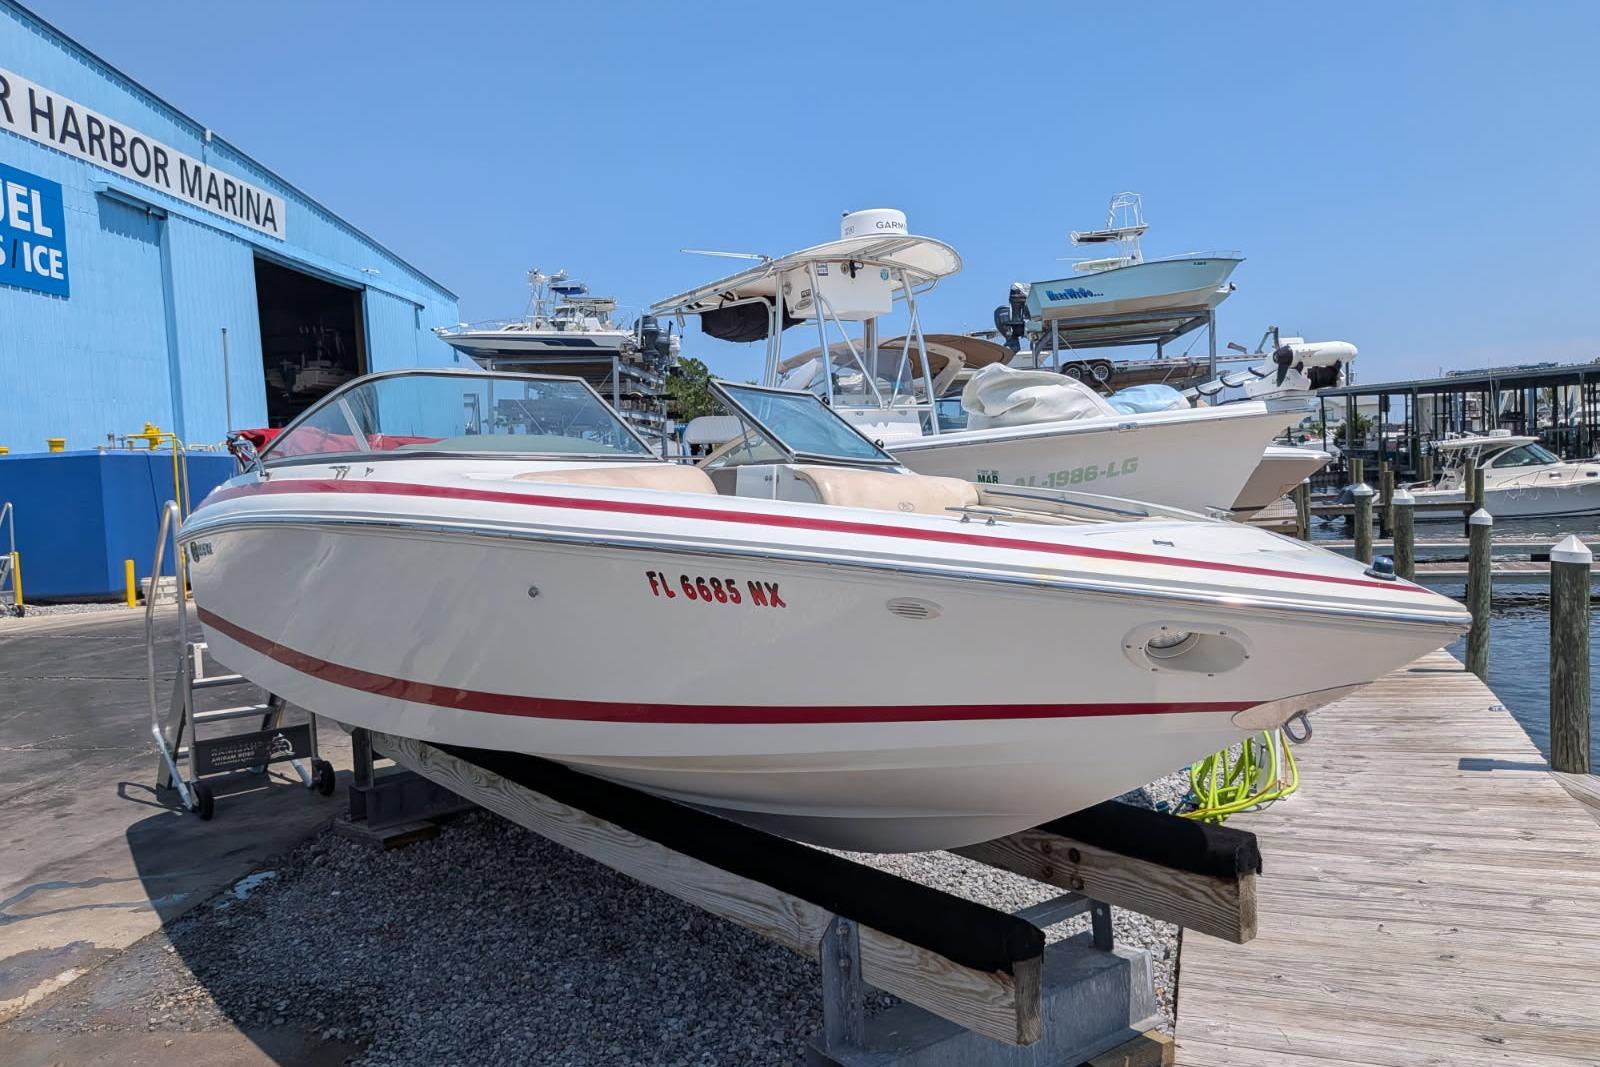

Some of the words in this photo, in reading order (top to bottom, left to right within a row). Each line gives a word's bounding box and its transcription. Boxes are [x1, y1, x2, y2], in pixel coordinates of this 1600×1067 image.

[28, 87, 170, 188] HARBOR
[179, 158, 278, 232] MARINA
[0, 178, 52, 238] EL
[23, 241, 65, 280] ICE
[646, 571, 676, 598] FL
[680, 575, 742, 604] 6685
[747, 581, 786, 608] NX
